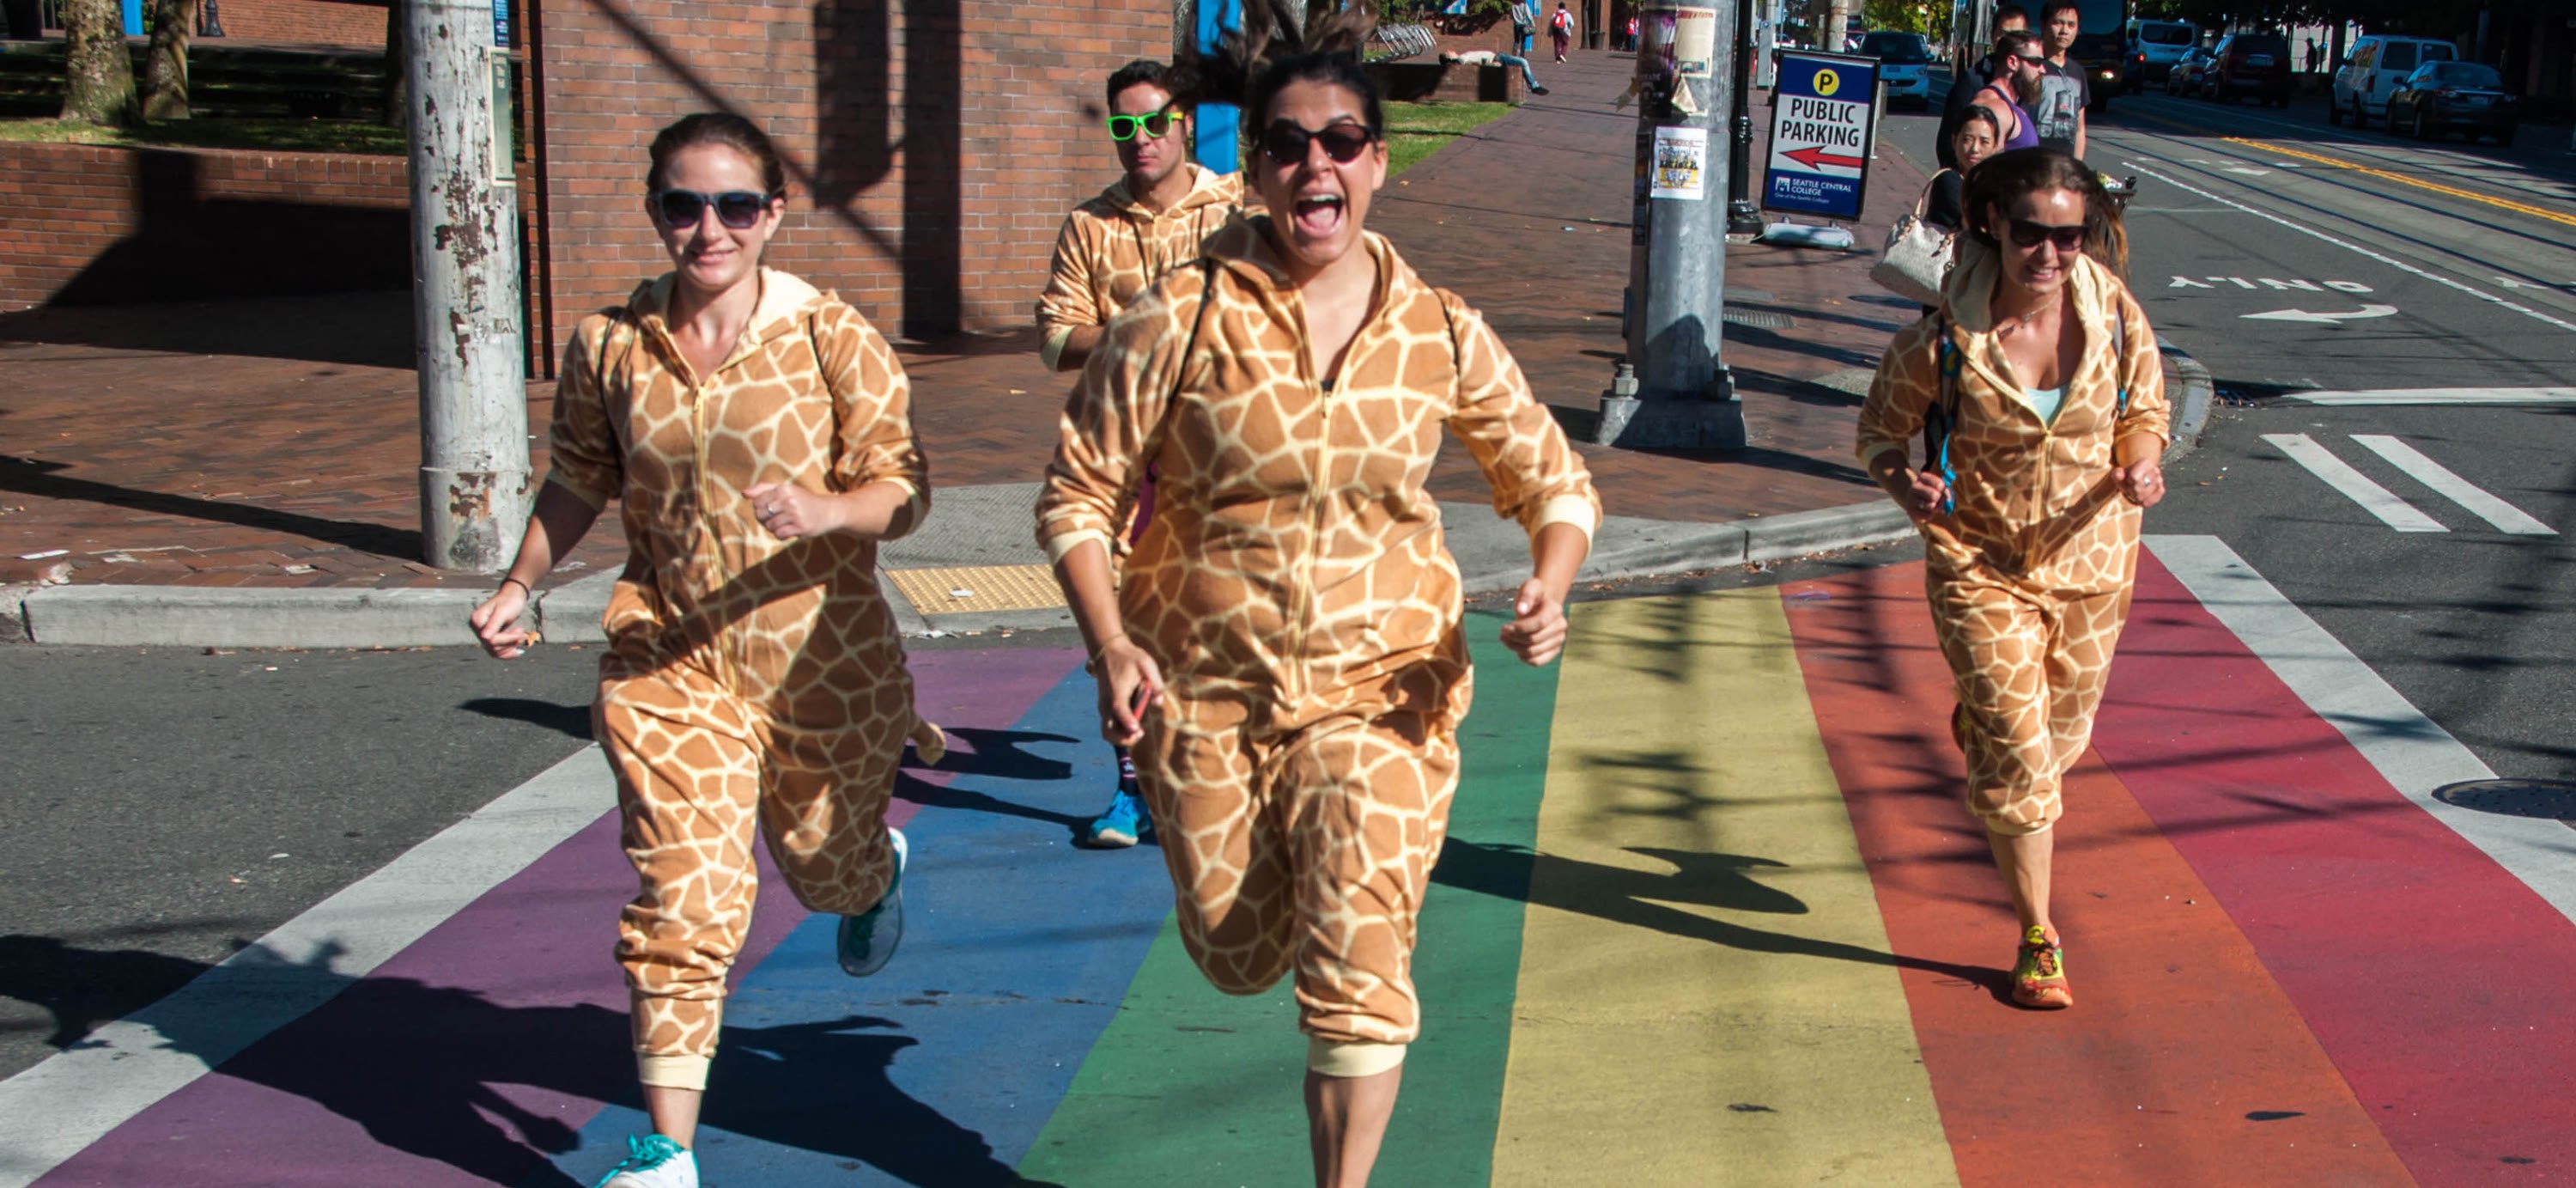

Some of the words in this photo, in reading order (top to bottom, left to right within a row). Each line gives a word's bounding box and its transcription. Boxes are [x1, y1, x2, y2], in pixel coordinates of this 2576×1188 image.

[1819, 73, 1833, 92] P
[1790, 98, 1856, 124] PUBLIC
[1780, 120, 1860, 147] PARKING
[1791, 186, 1821, 196] COLLEGE
[1792, 179, 1820, 188] SEATTLE
[1820, 182, 1851, 192] CENTRAL
[2168, 276, 2374, 293] ONLY
